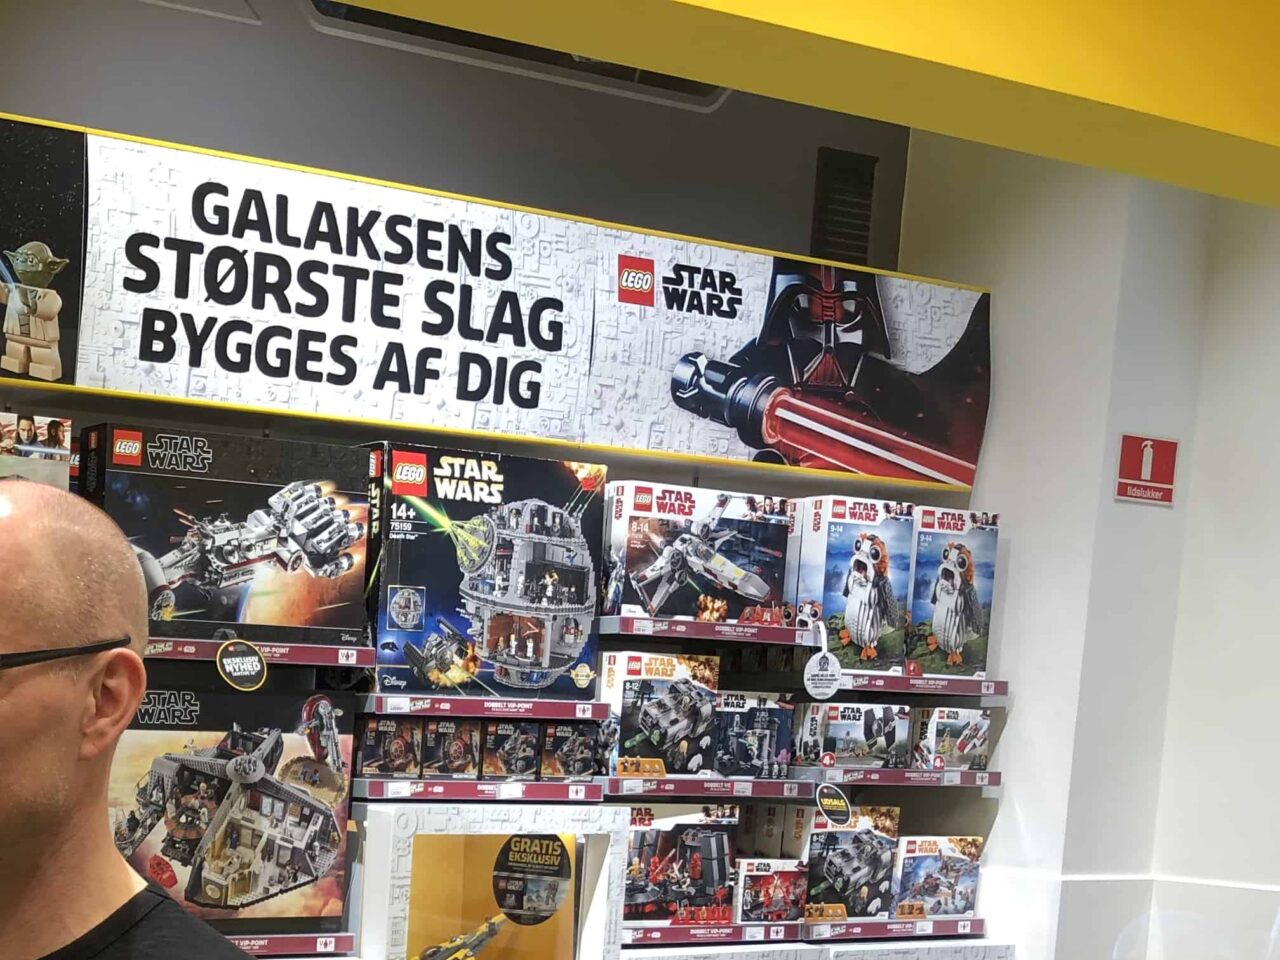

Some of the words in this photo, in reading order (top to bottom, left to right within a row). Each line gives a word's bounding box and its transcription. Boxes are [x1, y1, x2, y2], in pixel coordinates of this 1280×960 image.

[192, 182, 512, 280] GALAKSENS
[620, 268, 654, 293] LEGO
[662, 263, 743, 296] STAR
[123, 231, 404, 328] STØRSTE
[422, 282, 565, 352] SLAG
[662, 287, 743, 319] WARS
[139, 306, 358, 386] BYGGES
[373, 343, 442, 396] AF
[456, 354, 543, 409] DIG
[115, 441, 140, 454] LEGO
[147, 433, 212, 456] STAR
[147, 450, 212, 472] WARS
[394, 463, 426, 483] LEGO
[433, 456, 504, 482] STAR
[433, 478, 504, 503] WARS
[636, 494, 652, 504] LEGO
[656, 489, 695, 504] STAR
[390, 503, 416, 519] 14+
[656, 501, 695, 516] WARS
[849, 501, 878, 512] STAR
[849, 511, 878, 522] WARS
[937, 512, 965, 522] STAR
[390, 522, 412, 531] 75159
[631, 522, 648, 532] 8-14
[830, 525, 843, 533] 9-14
[937, 521, 965, 531] WARS
[260, 646, 289, 654] VIP-POINT
[222, 655, 259, 665] EKSKLUSIV
[628, 661, 641, 670] LEGO
[645, 657, 675, 668] STAR
[224, 662, 261, 673] NYHED
[645, 666, 675, 677] WARS
[382, 674, 407, 690] Disney
[625, 682, 639, 690] 8-12
[139, 691, 200, 708] STAR
[724, 694, 746, 702] STAR
[724, 700, 746, 708] WARS
[137, 705, 200, 725] WARS
[840, 707, 862, 715] STAR
[840, 713, 862, 721] WARS
[822, 755, 835, 765] 4+
[934, 758, 945, 767] 4+
[630, 807, 653, 817] TAR
[630, 816, 654, 827] ARS
[510, 837, 561, 855] GRATIS
[508, 851, 561, 865] EKSKLUSIV
[240, 939, 268, 947] VIP-POINT
